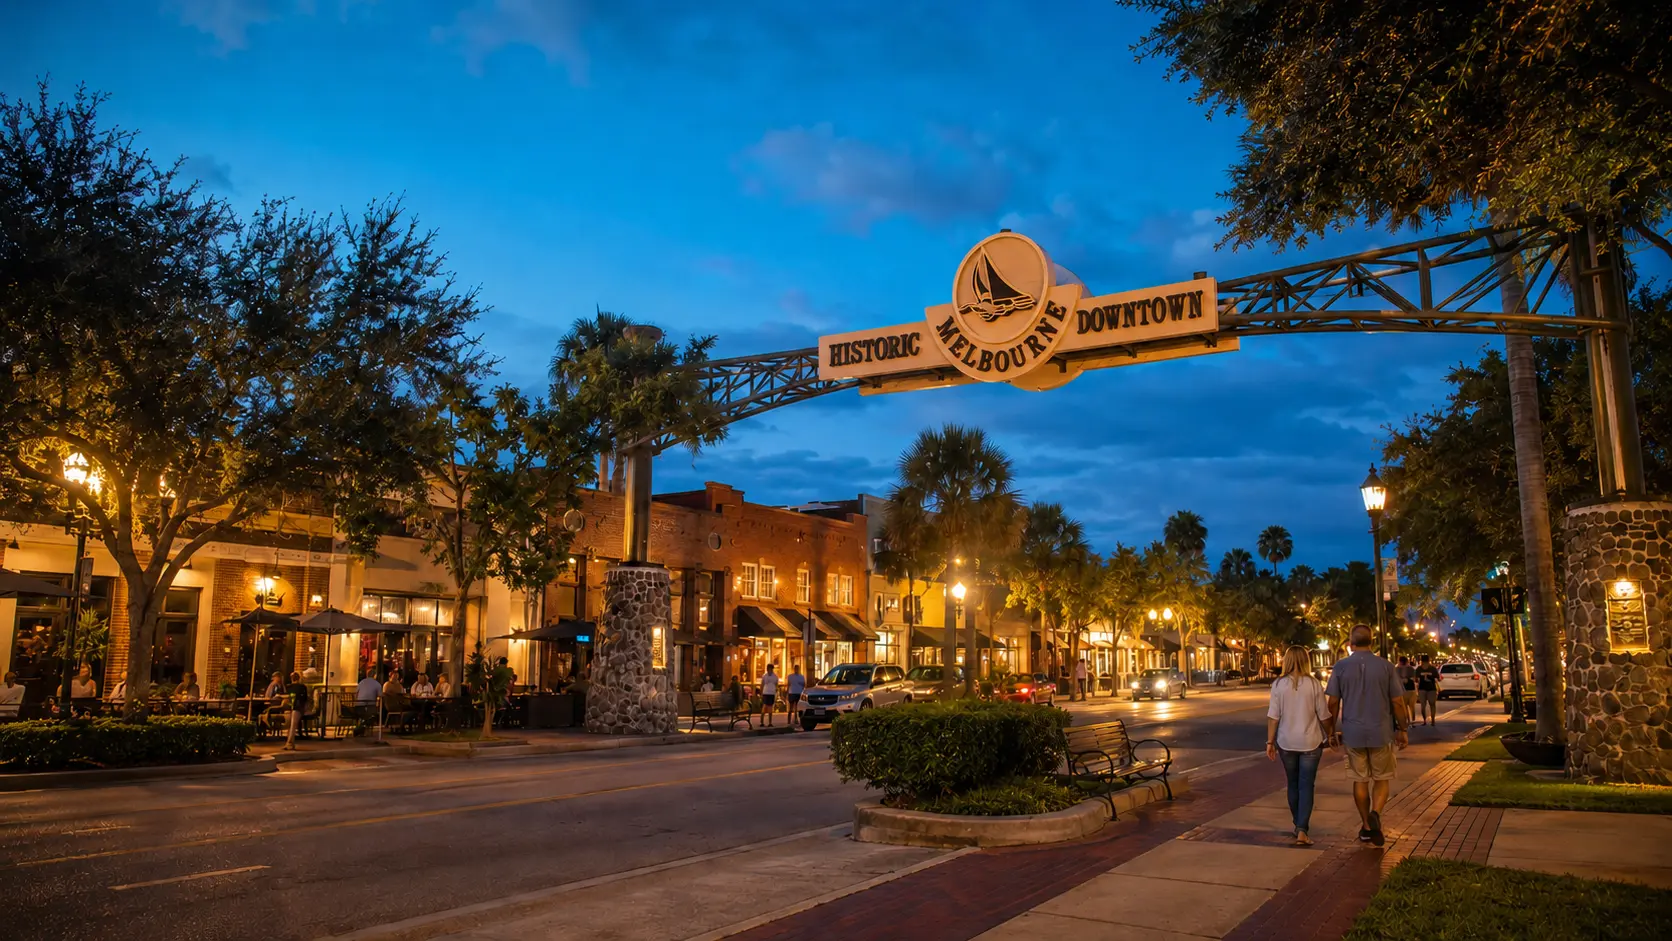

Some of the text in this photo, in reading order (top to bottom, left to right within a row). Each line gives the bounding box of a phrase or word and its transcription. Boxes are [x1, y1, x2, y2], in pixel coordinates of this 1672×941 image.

[1076, 290, 1203, 334] DOWNTOWN
[829, 332, 920, 367] HISTORIC
[936, 300, 1067, 372] MELBOURNE
